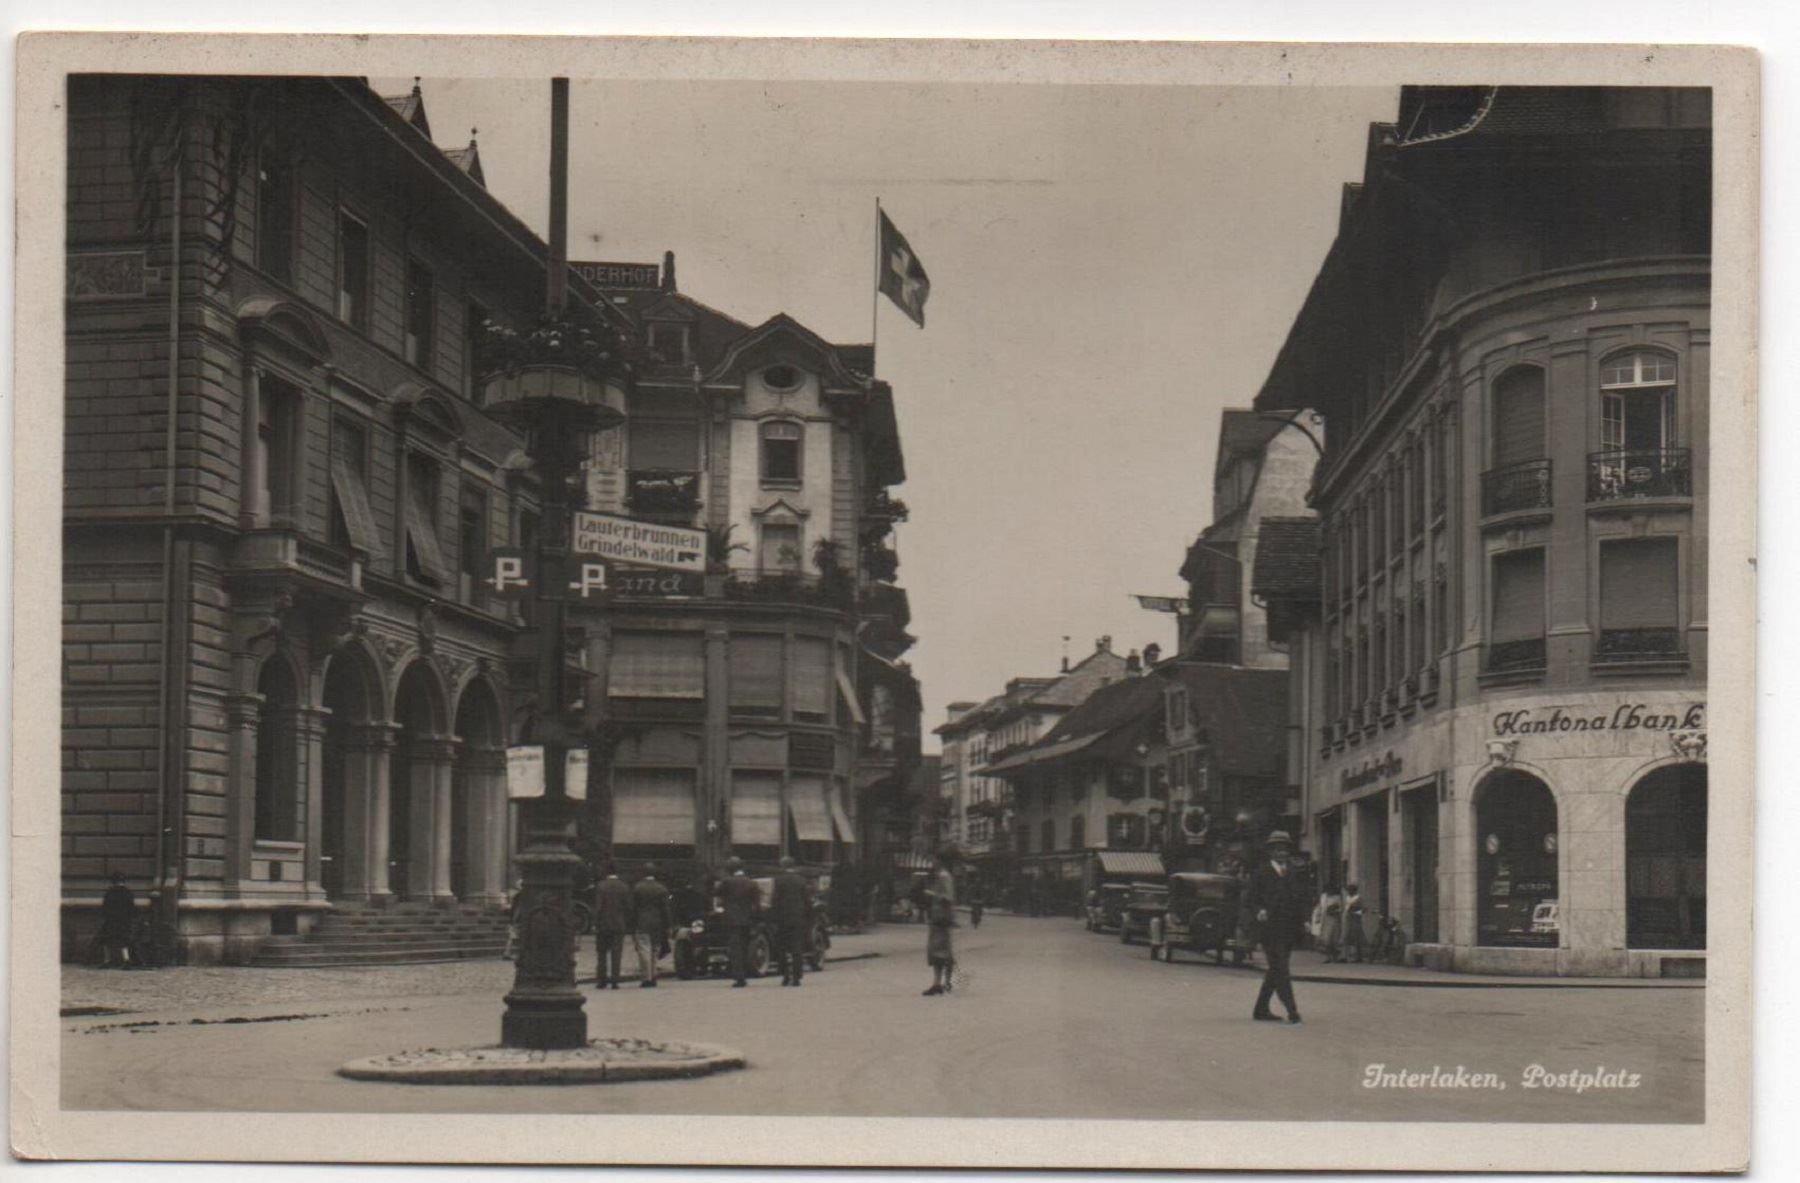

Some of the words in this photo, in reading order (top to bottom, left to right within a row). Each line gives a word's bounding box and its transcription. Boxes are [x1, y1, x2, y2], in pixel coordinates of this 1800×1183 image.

[578, 515, 700, 548] Lauterbrunnen
[578, 535, 675, 563] Grindelwald
[496, 557, 521, 591] P
[581, 563, 605, 597] P
[1493, 703, 1704, 736] Kantonalbank
